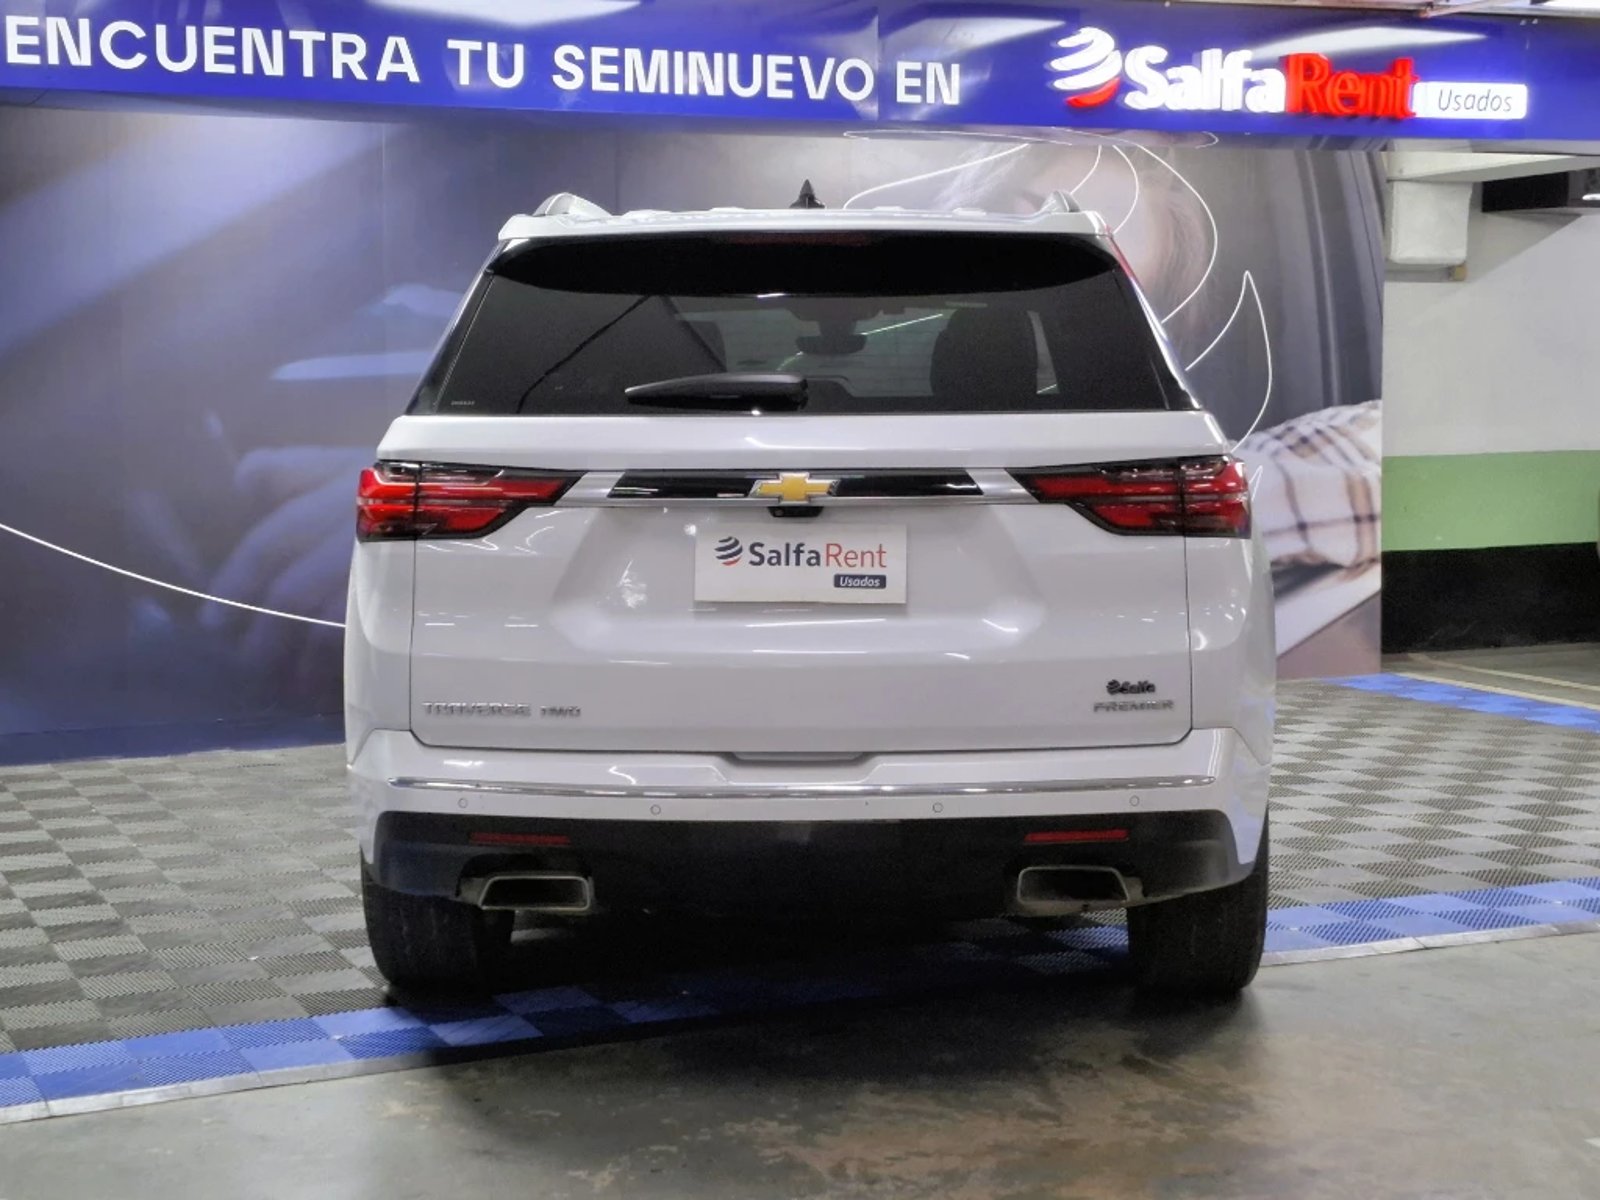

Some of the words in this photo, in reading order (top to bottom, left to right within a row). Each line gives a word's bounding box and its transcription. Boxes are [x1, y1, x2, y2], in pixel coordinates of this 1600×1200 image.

[5, 15, 420, 83] ENCUENTRA
[447, 40, 524, 88] TU
[552, 44, 875, 101] SEMINUEVO
[896, 61, 960, 105] EN
[1437, 88, 1513, 113] Usados
[839, 575, 881, 588] Usados
[422, 702, 532, 717] TRAVERSE
[1093, 700, 1175, 713] PREMIER
